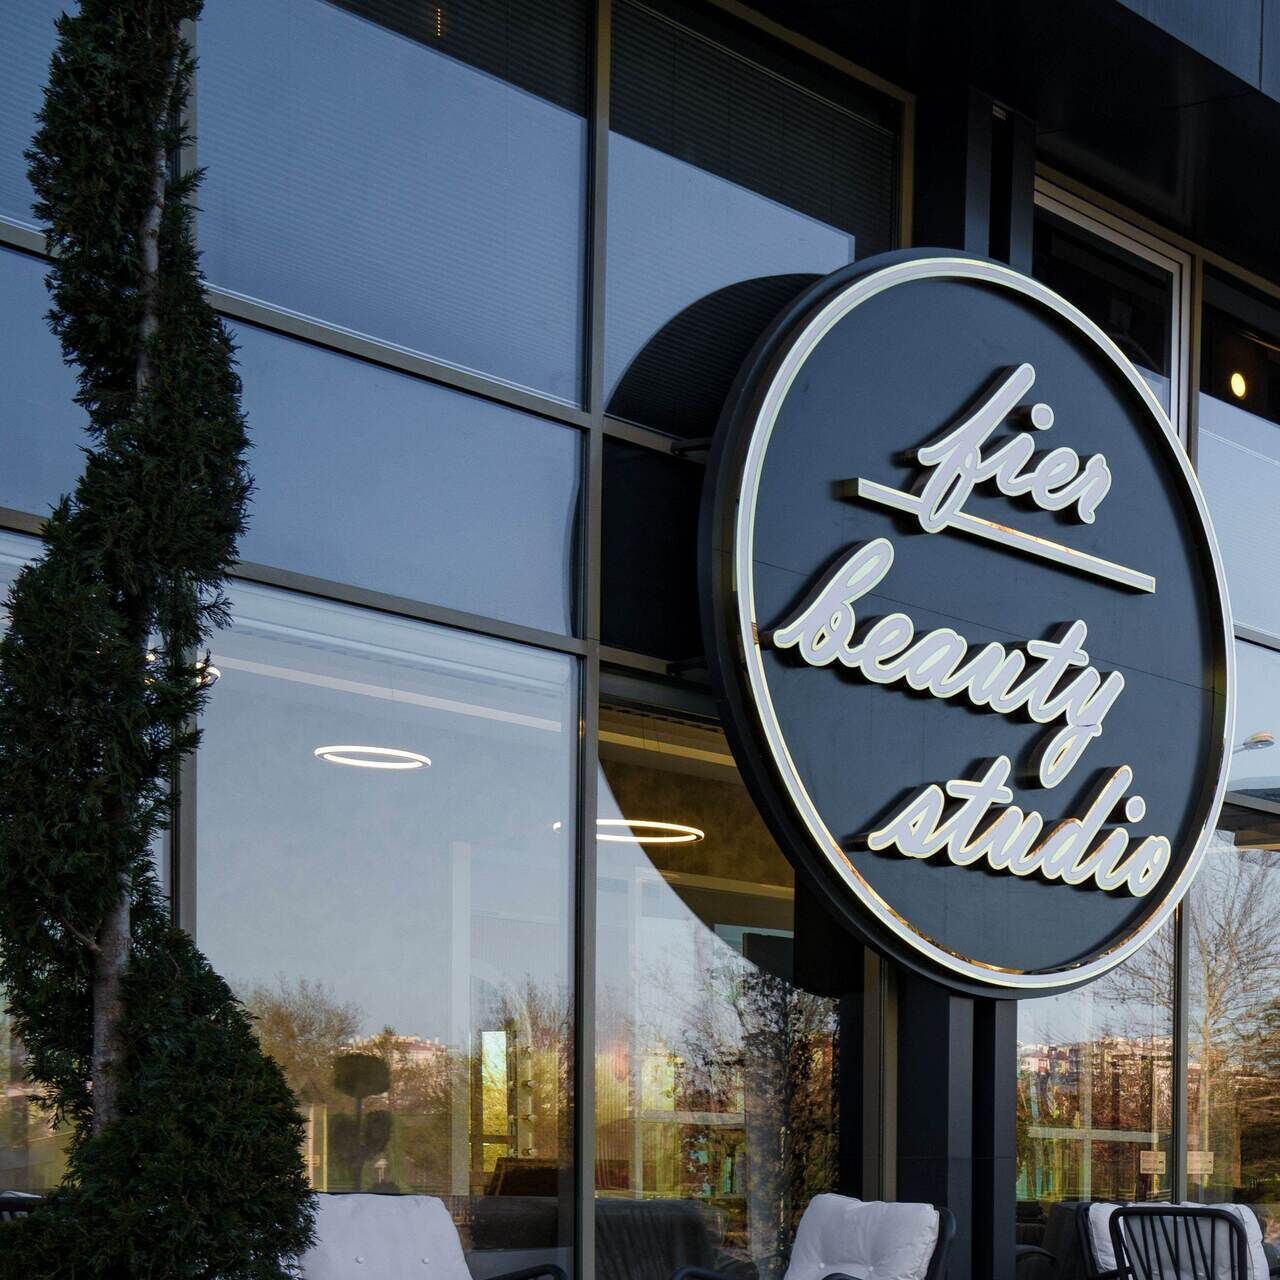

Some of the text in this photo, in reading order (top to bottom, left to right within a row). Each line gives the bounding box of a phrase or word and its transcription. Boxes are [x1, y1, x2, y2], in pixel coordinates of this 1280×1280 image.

[917, 362, 1112, 533] fier
[773, 537, 1125, 788] beauty
[868, 756, 1171, 897] studio
